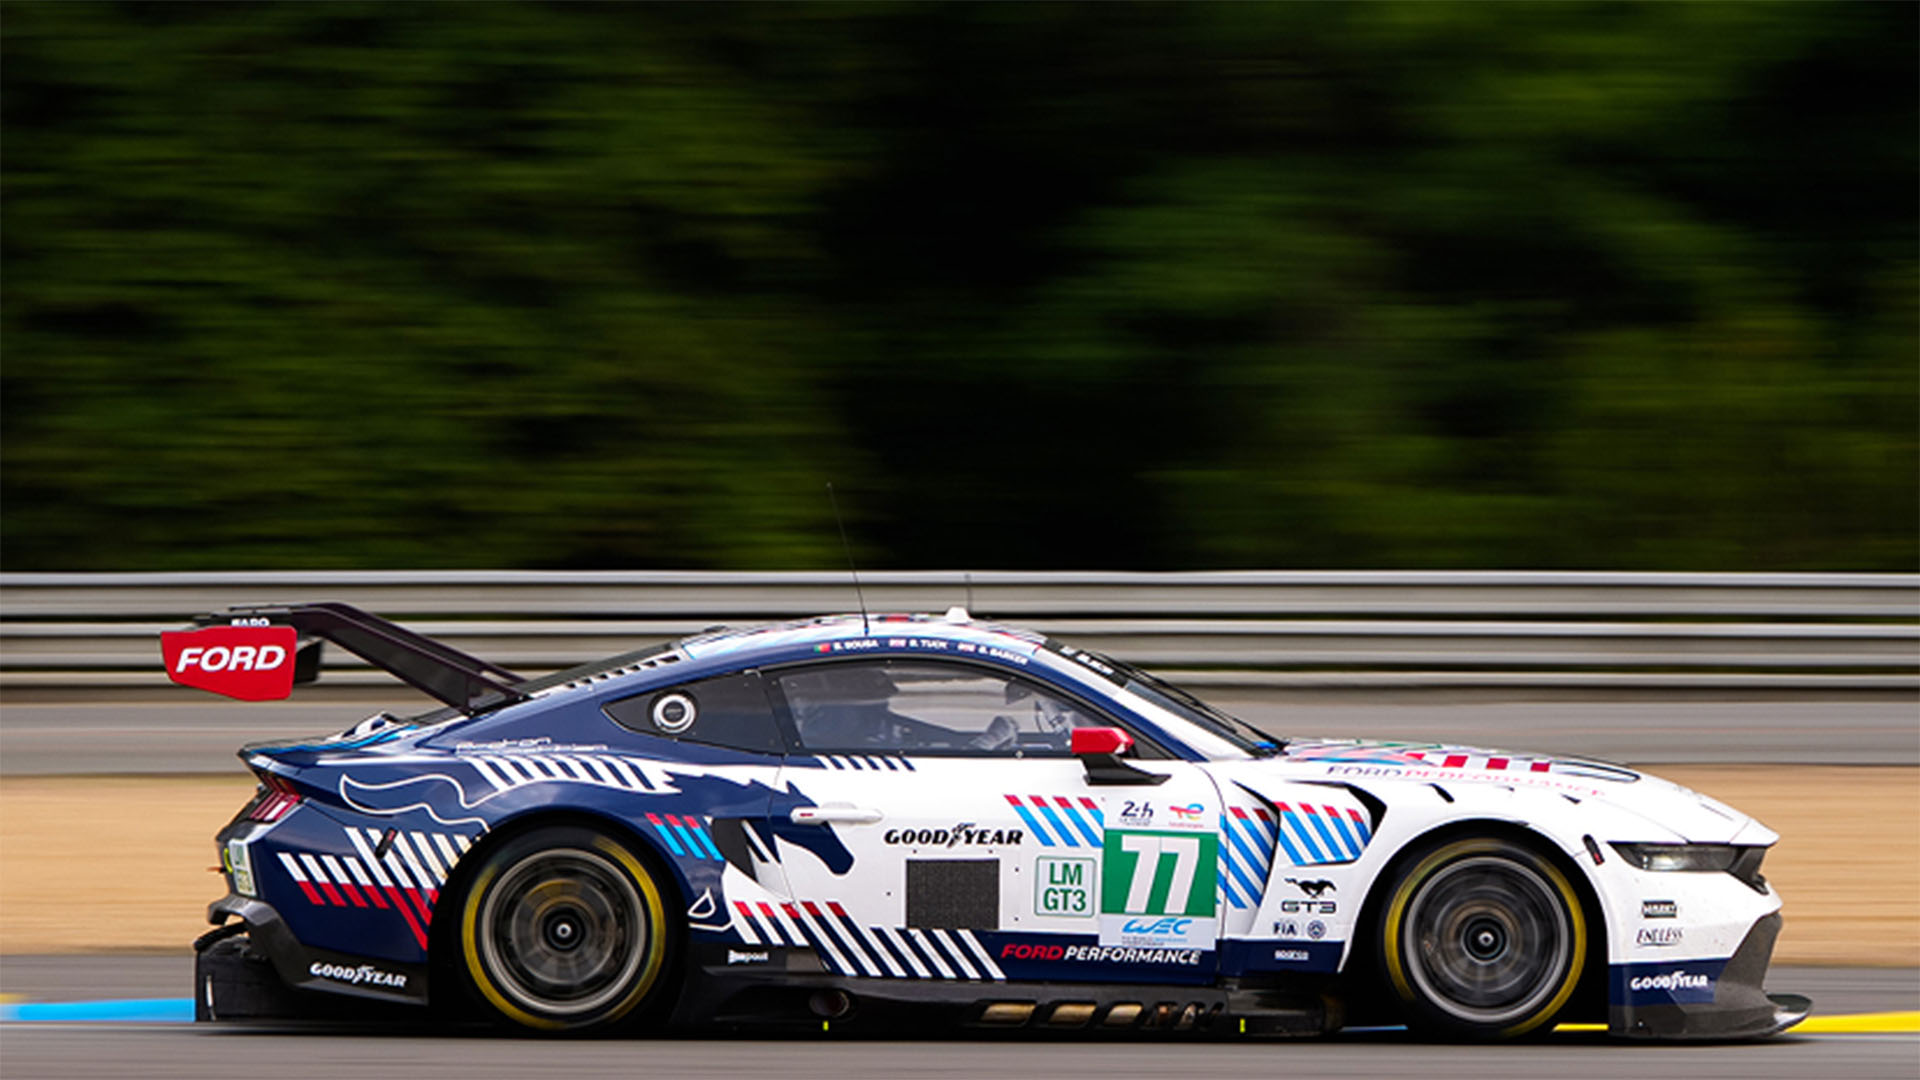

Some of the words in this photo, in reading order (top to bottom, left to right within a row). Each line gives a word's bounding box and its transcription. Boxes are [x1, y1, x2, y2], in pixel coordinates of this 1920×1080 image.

[845, 639, 879, 650] SOUSA
[921, 639, 948, 649] TUCK
[176, 646, 286, 672] FORD
[884, 823, 1023, 848] GOODYEAR
[1049, 862, 1083, 886] LM
[1122, 835, 1200, 914] 77
[1043, 887, 1087, 912] GT3
[1281, 900, 1337, 914] GT3
[1122, 918, 1193, 935] WEC
[1273, 922, 1297, 936] FIA
[309, 962, 407, 988] GOODYEAR
[1630, 970, 1708, 990] GOODYEAR
